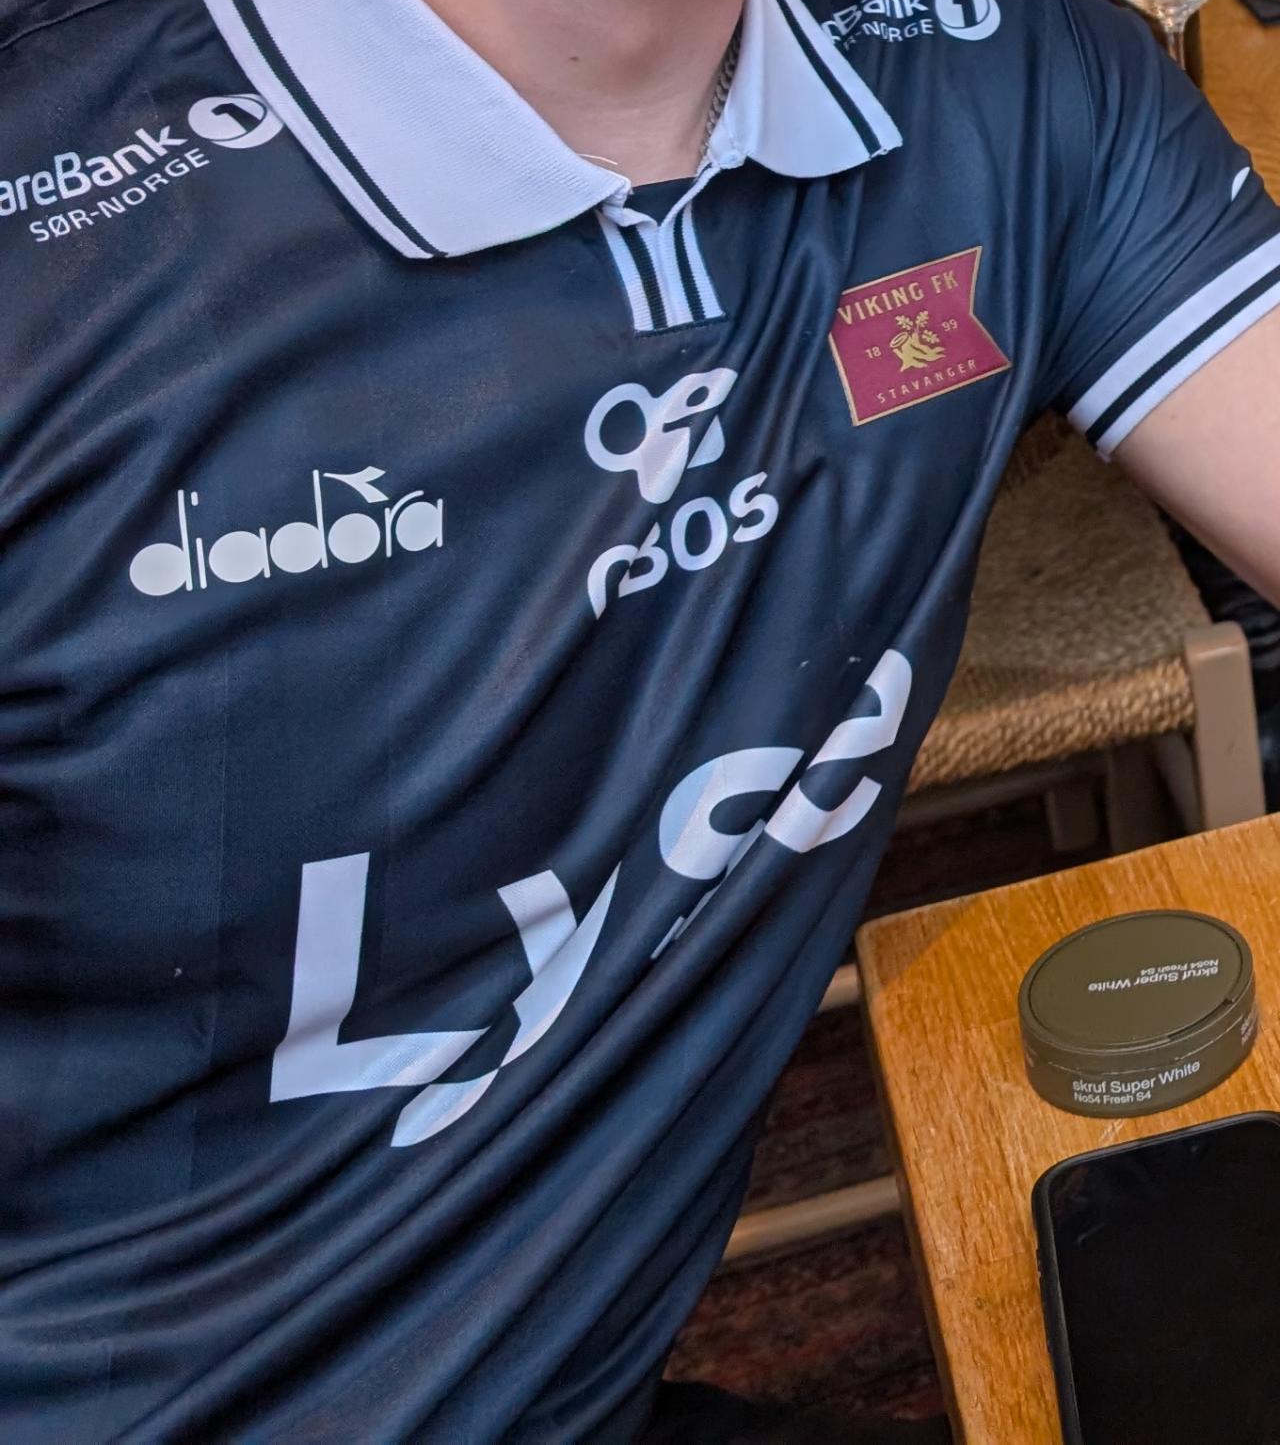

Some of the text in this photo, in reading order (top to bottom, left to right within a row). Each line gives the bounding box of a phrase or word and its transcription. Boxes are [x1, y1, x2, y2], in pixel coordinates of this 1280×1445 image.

[29, 147, 211, 243] SØR-NORGE
[837, 270, 960, 325] VIKING FK
[865, 318, 959, 360] 18 99
[876, 358, 977, 404] STAVANGER
[129, 468, 443, 596] diadora
[1087, 966, 1219, 992] skruf Super White
[1072, 1060, 1201, 1095] skruf Super White
[1103, 1094, 1134, 1105] Fresh
[1136, 1091, 1152, 1102] S4
